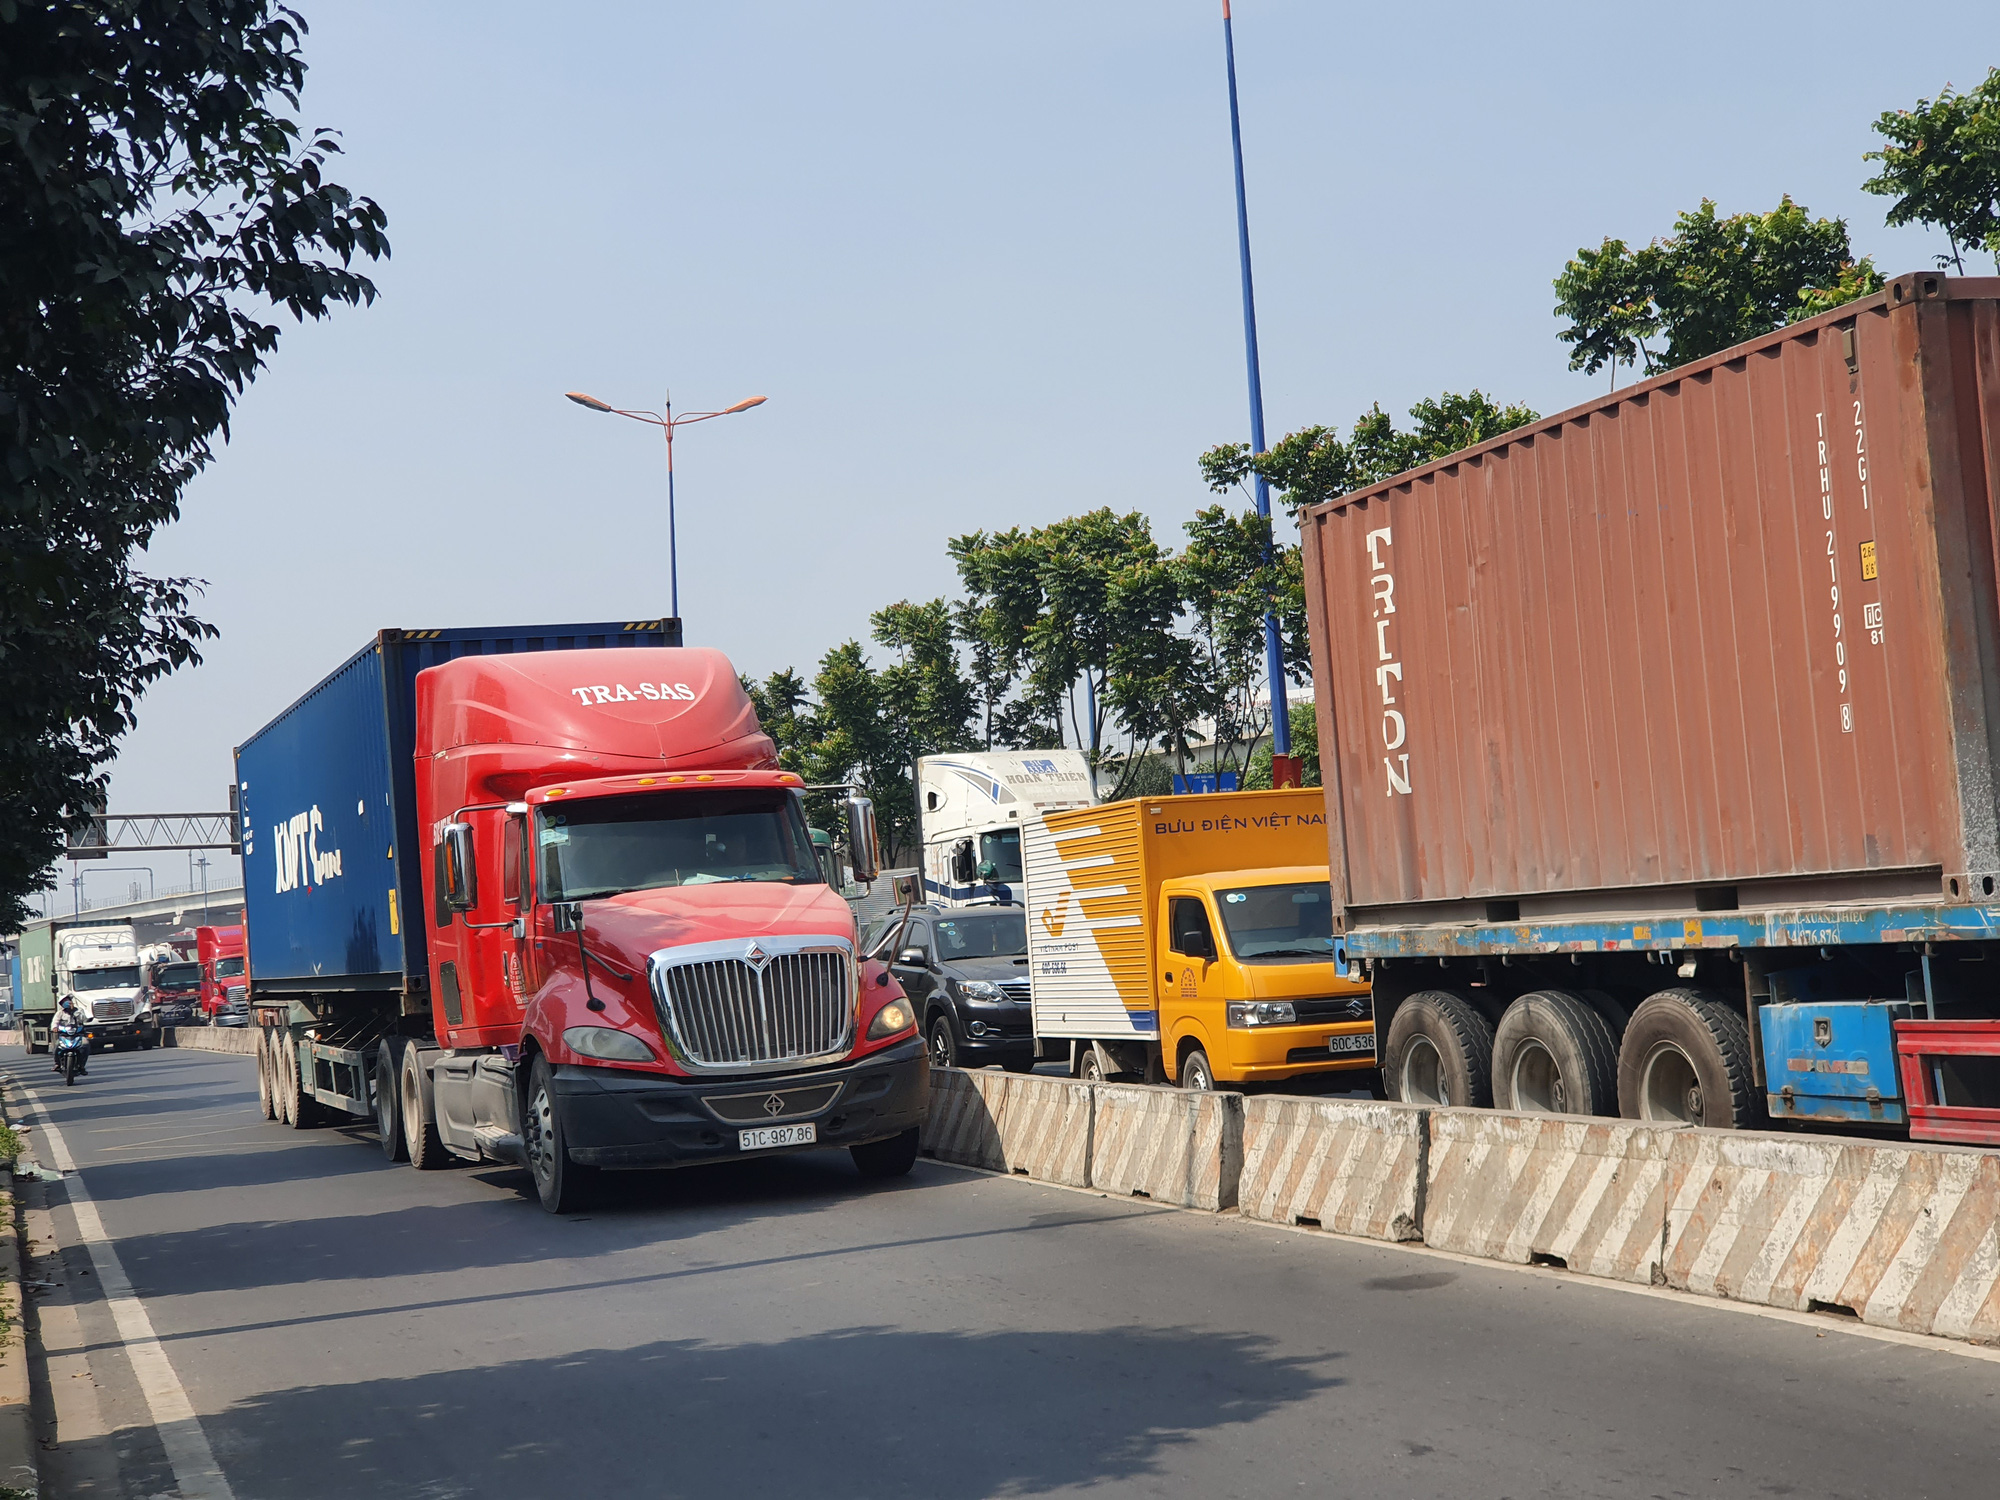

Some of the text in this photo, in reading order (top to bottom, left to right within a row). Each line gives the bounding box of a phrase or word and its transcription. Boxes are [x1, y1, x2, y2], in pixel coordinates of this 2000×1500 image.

[1853, 400, 1868, 510] 22G1
[1816, 413, 1851, 731] TRHU 219909 8
[571, 682, 696, 706] TRA-SAS
[1366, 526, 1412, 798] TRITON
[1155, 811, 1327, 835] BƯU ĐIỆN VIỆT NA
